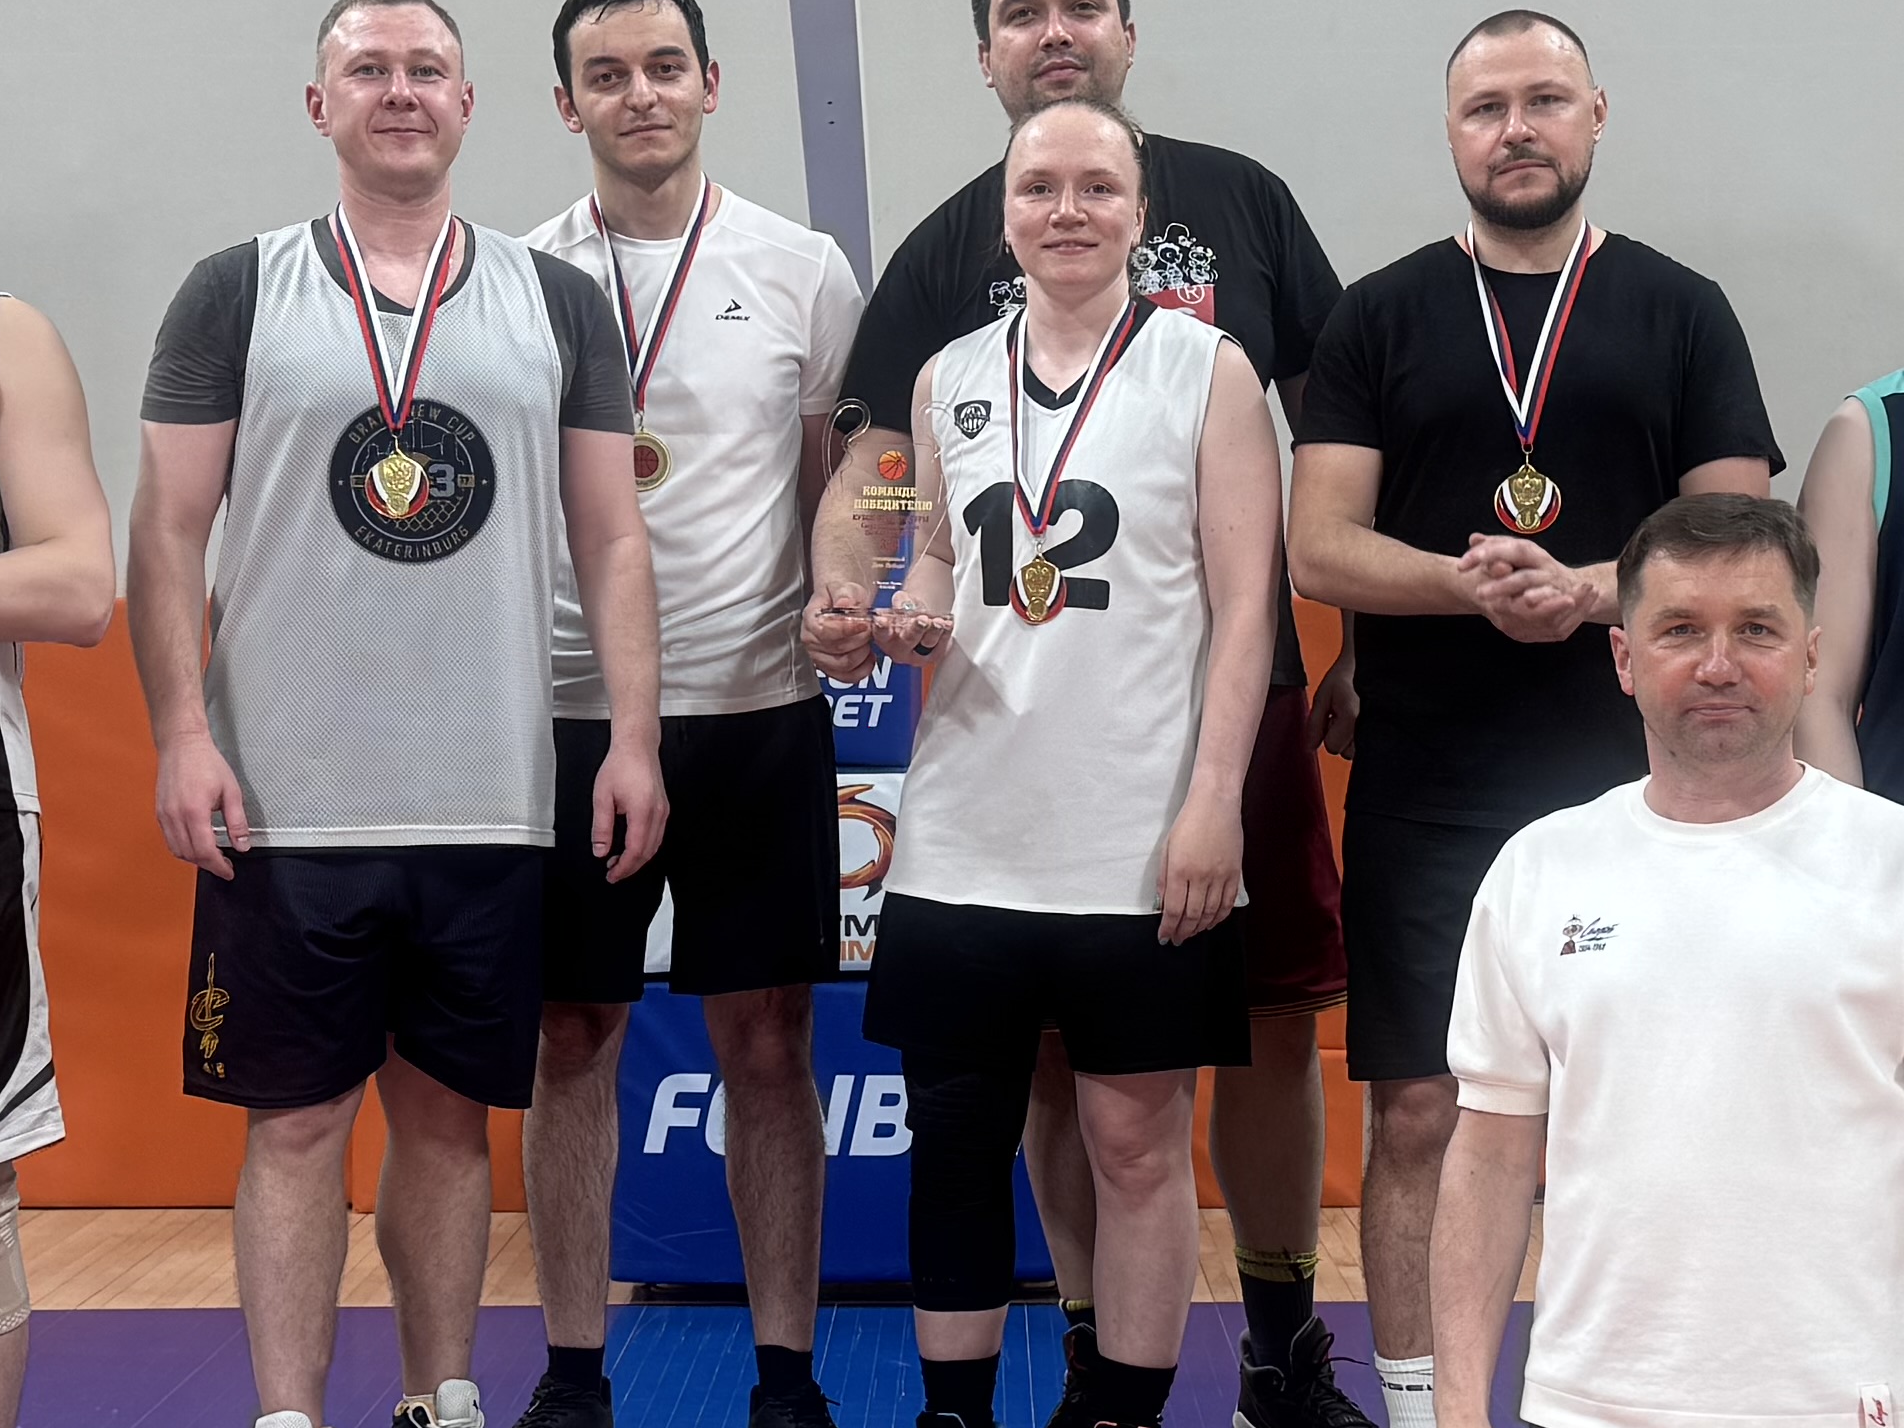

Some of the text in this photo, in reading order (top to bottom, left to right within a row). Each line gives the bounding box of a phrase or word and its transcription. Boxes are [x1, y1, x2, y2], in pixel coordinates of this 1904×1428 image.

[853, 498, 934, 511] ПОБЕДИТЕЛЮ
[862, 485, 917, 499] КОМАНДЕ
[353, 524, 470, 560] EKATERINBURG
[962, 478, 1120, 611] 12
